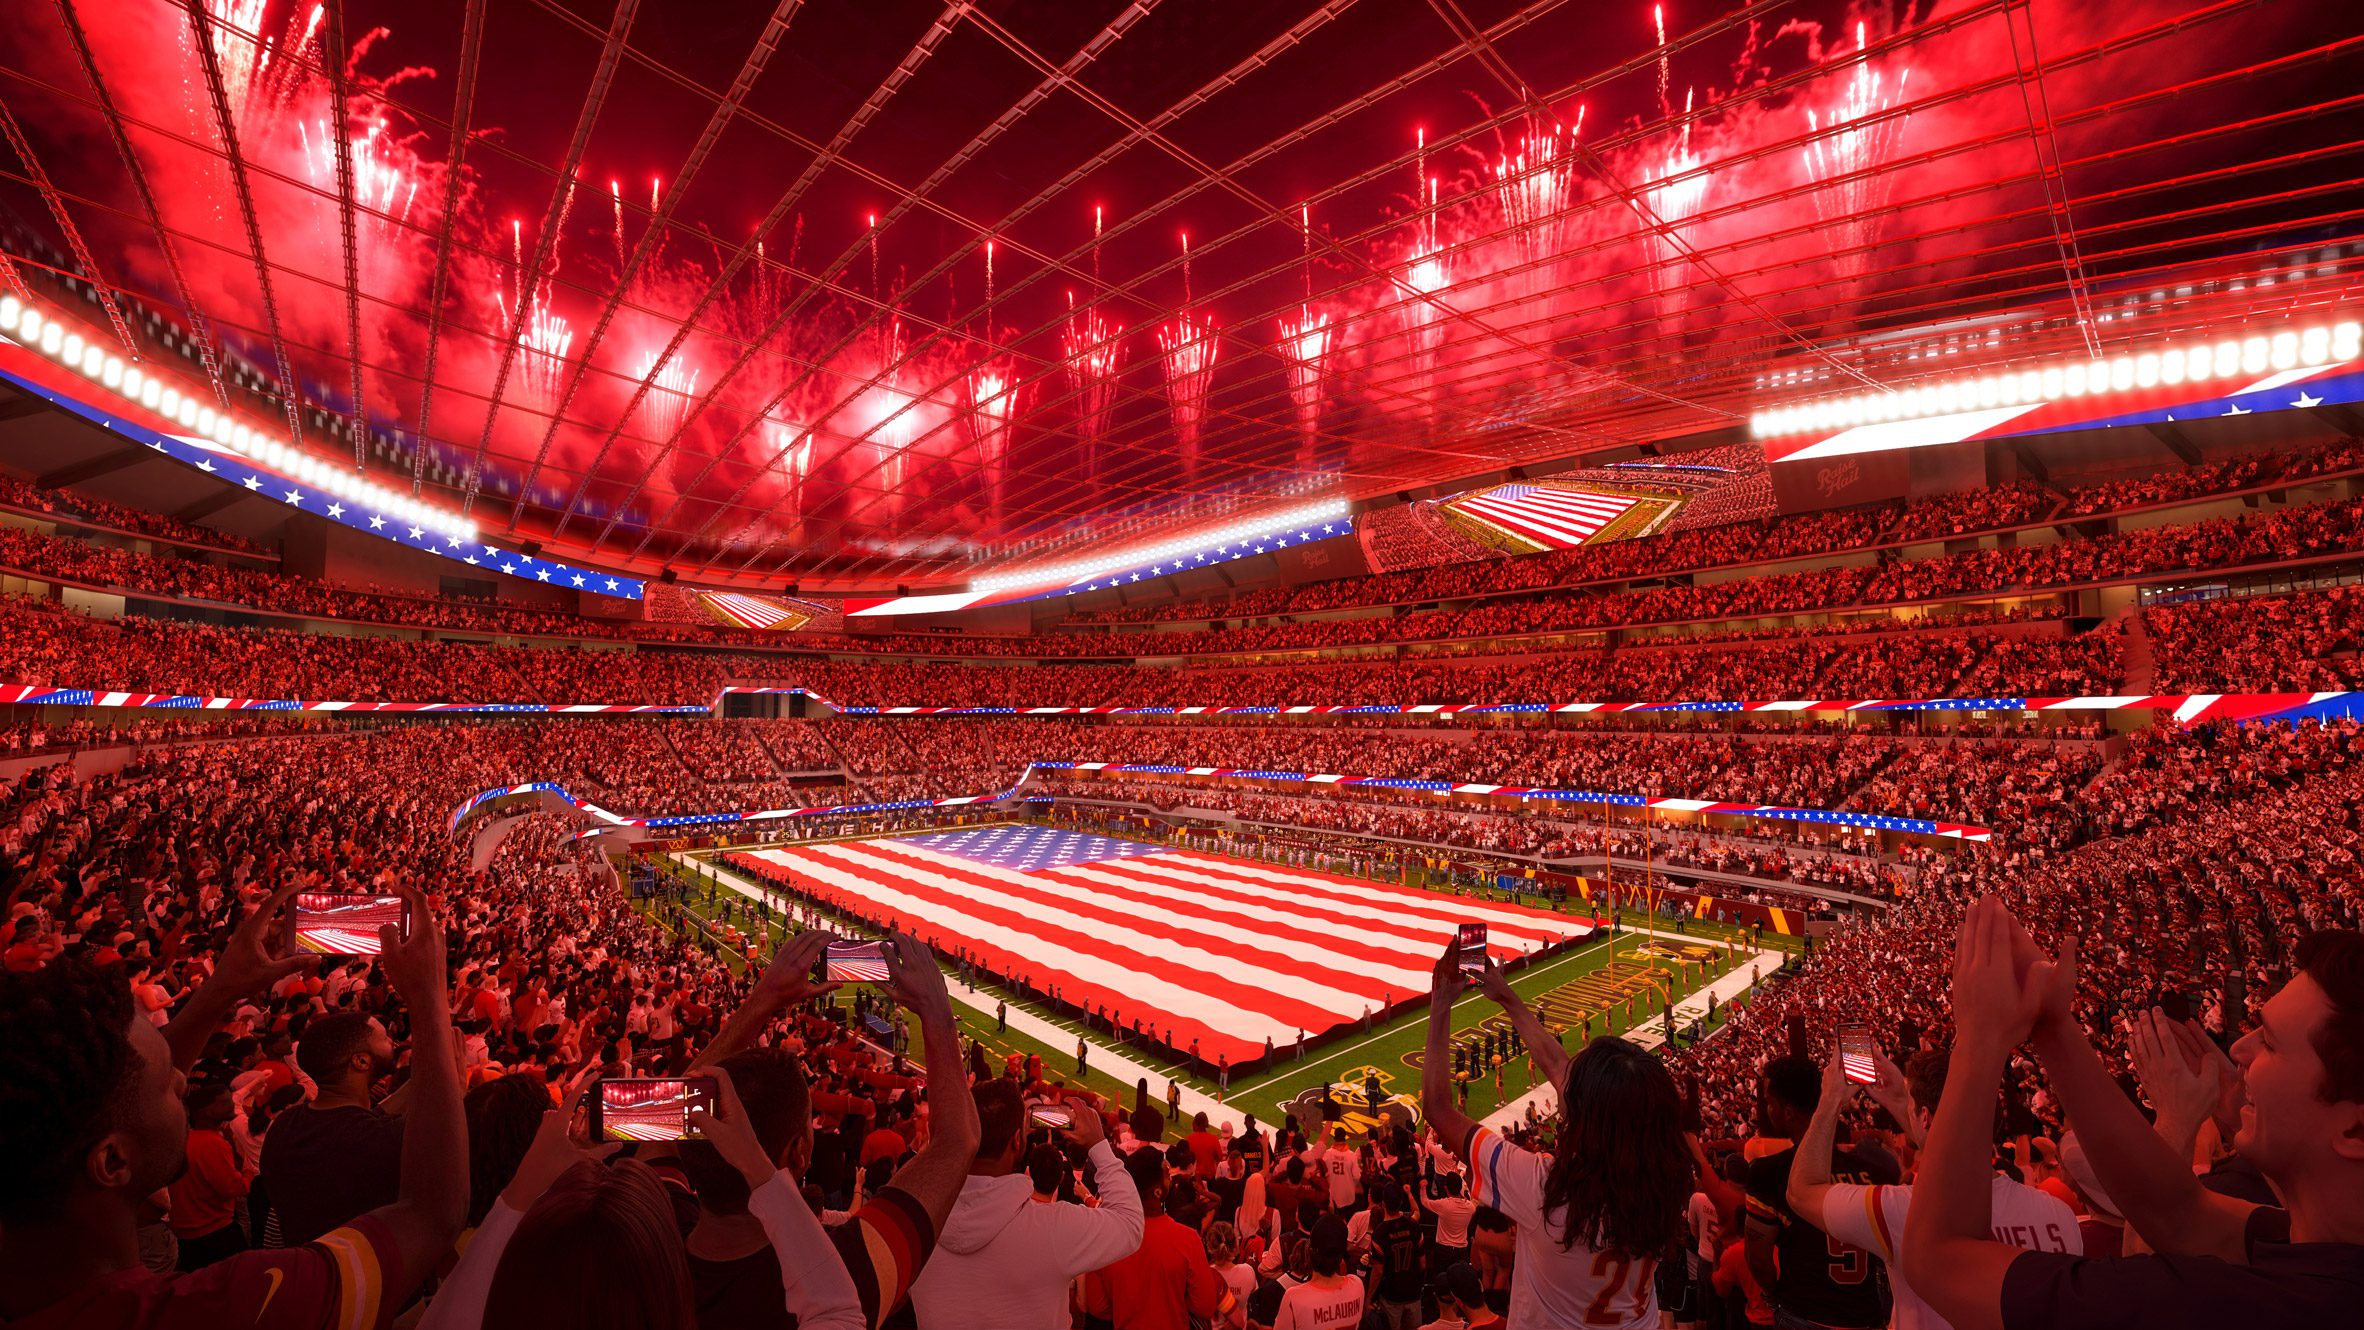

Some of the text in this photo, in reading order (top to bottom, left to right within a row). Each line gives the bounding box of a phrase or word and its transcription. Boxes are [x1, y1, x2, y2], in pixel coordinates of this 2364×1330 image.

[1817, 456, 1857, 490] Raise
[1825, 466, 1859, 497] Hail
[1332, 1161, 1345, 1175] 21
[1391, 1241, 1413, 1273] 17
[1313, 1297, 1361, 1325] McLAURIN
